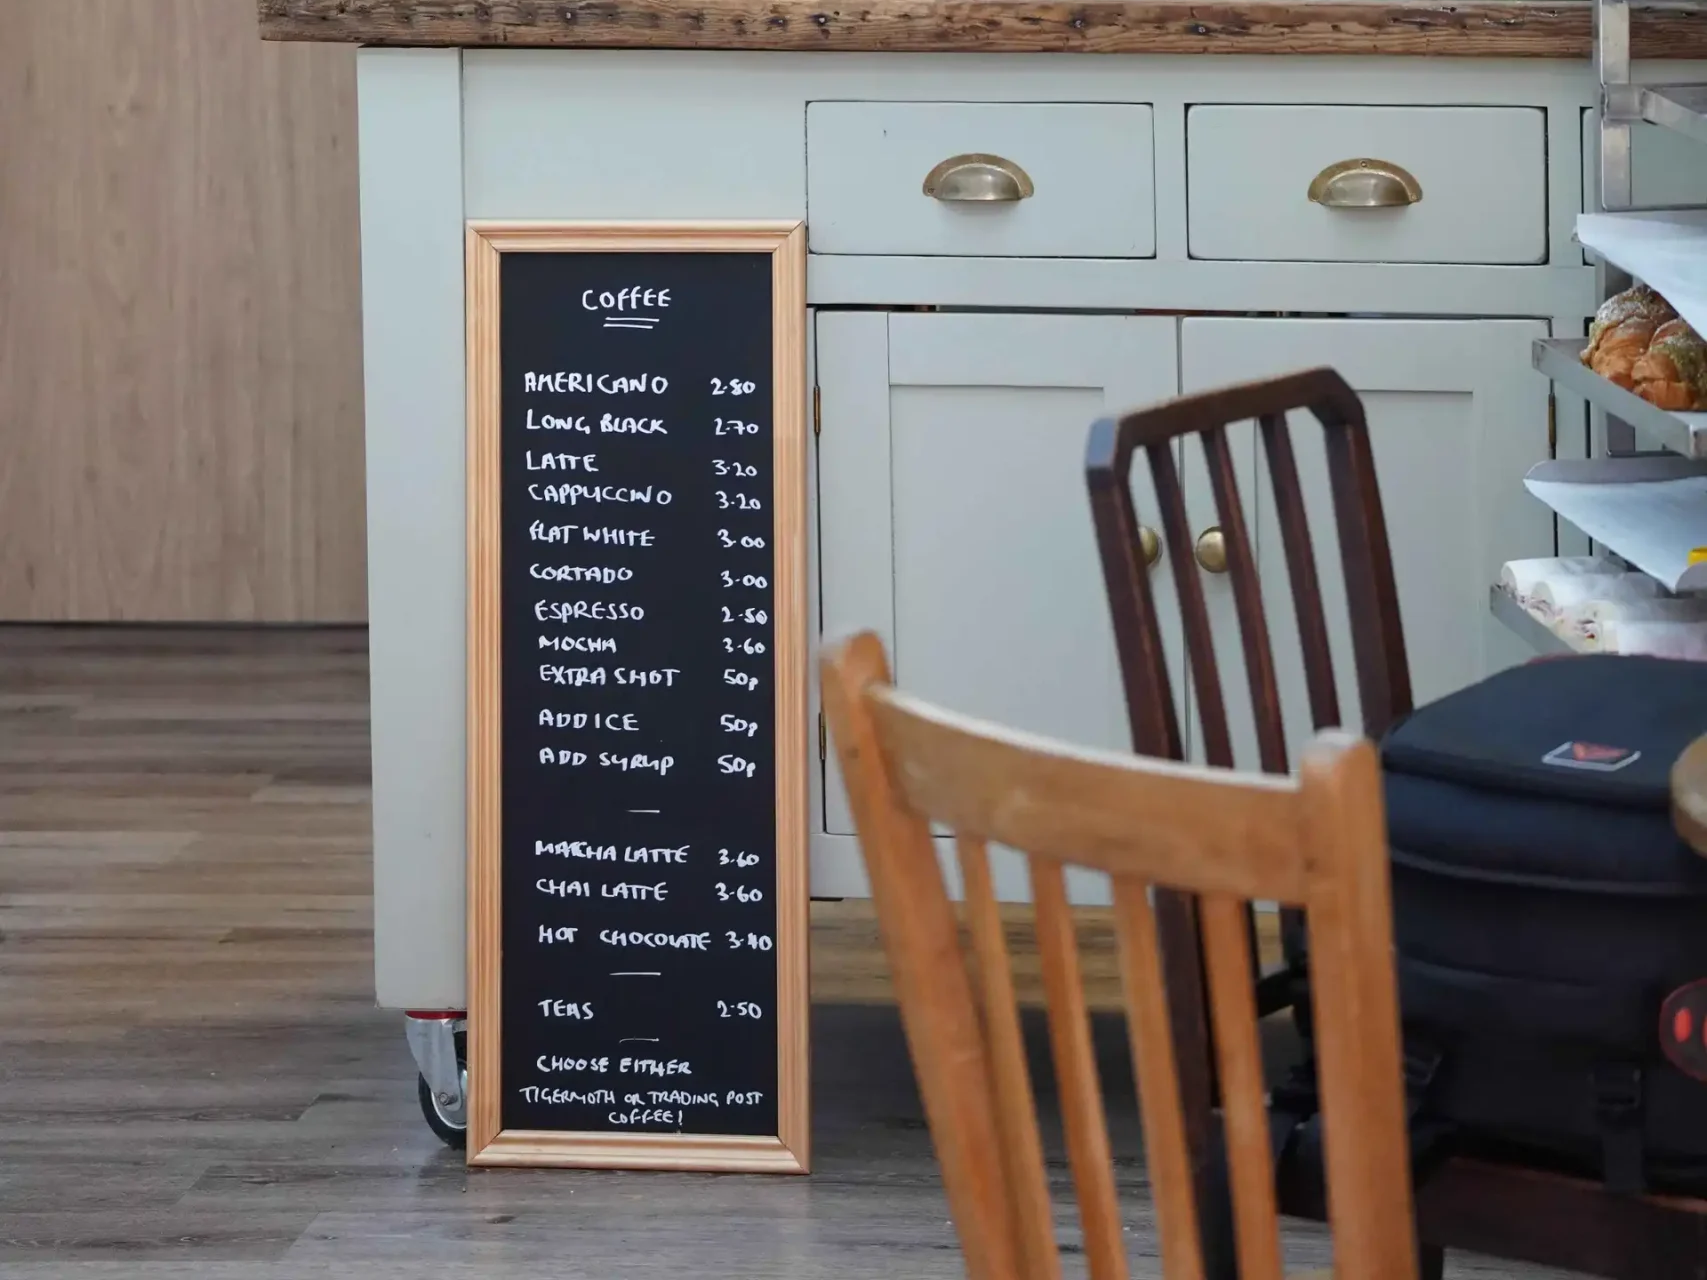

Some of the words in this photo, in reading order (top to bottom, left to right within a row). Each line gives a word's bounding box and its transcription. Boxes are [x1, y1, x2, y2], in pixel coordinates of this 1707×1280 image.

[581, 285, 672, 312] COFFEE
[524, 371, 669, 395] AMERICANO
[526, 408, 591, 435] LONG
[599, 412, 668, 435] BLACK
[525, 449, 599, 473] LATTE
[527, 483, 673, 506] CAPPUCCINO
[528, 519, 579, 545] FLAT
[582, 526, 656, 547] WHITE
[529, 563, 634, 584] CORTADO
[534, 599, 645, 624] ESPRESSO
[538, 634, 617, 654] MOCHA
[539, 663, 607, 687] EXTRA
[613, 667, 681, 687] SHOT
[723, 668, 759, 691] 50p
[538, 708, 588, 729] ADD
[594, 712, 640, 731] ICE
[720, 713, 759, 738] 50p
[539, 746, 588, 766] ADD
[598, 751, 675, 776] SYRUP
[717, 754, 756, 778] 50p
[624, 844, 691, 864] LATTE
[535, 878, 590, 898] CHAI
[601, 881, 669, 902] LATTE
[538, 924, 579, 944] HOT
[599, 929, 712, 951] CHOCOLATE
[537, 999, 594, 1020] TEAS
[536, 1055, 610, 1073] CHOOSE
[619, 1057, 693, 1077] EITHER
[518, 1085, 616, 1105] TIGERMOTH
[623, 1092, 646, 1106] OR
[646, 1089, 720, 1108] TRADING
[726, 1090, 764, 1105] POST
[608, 1108, 683, 1126] COFFEE!
